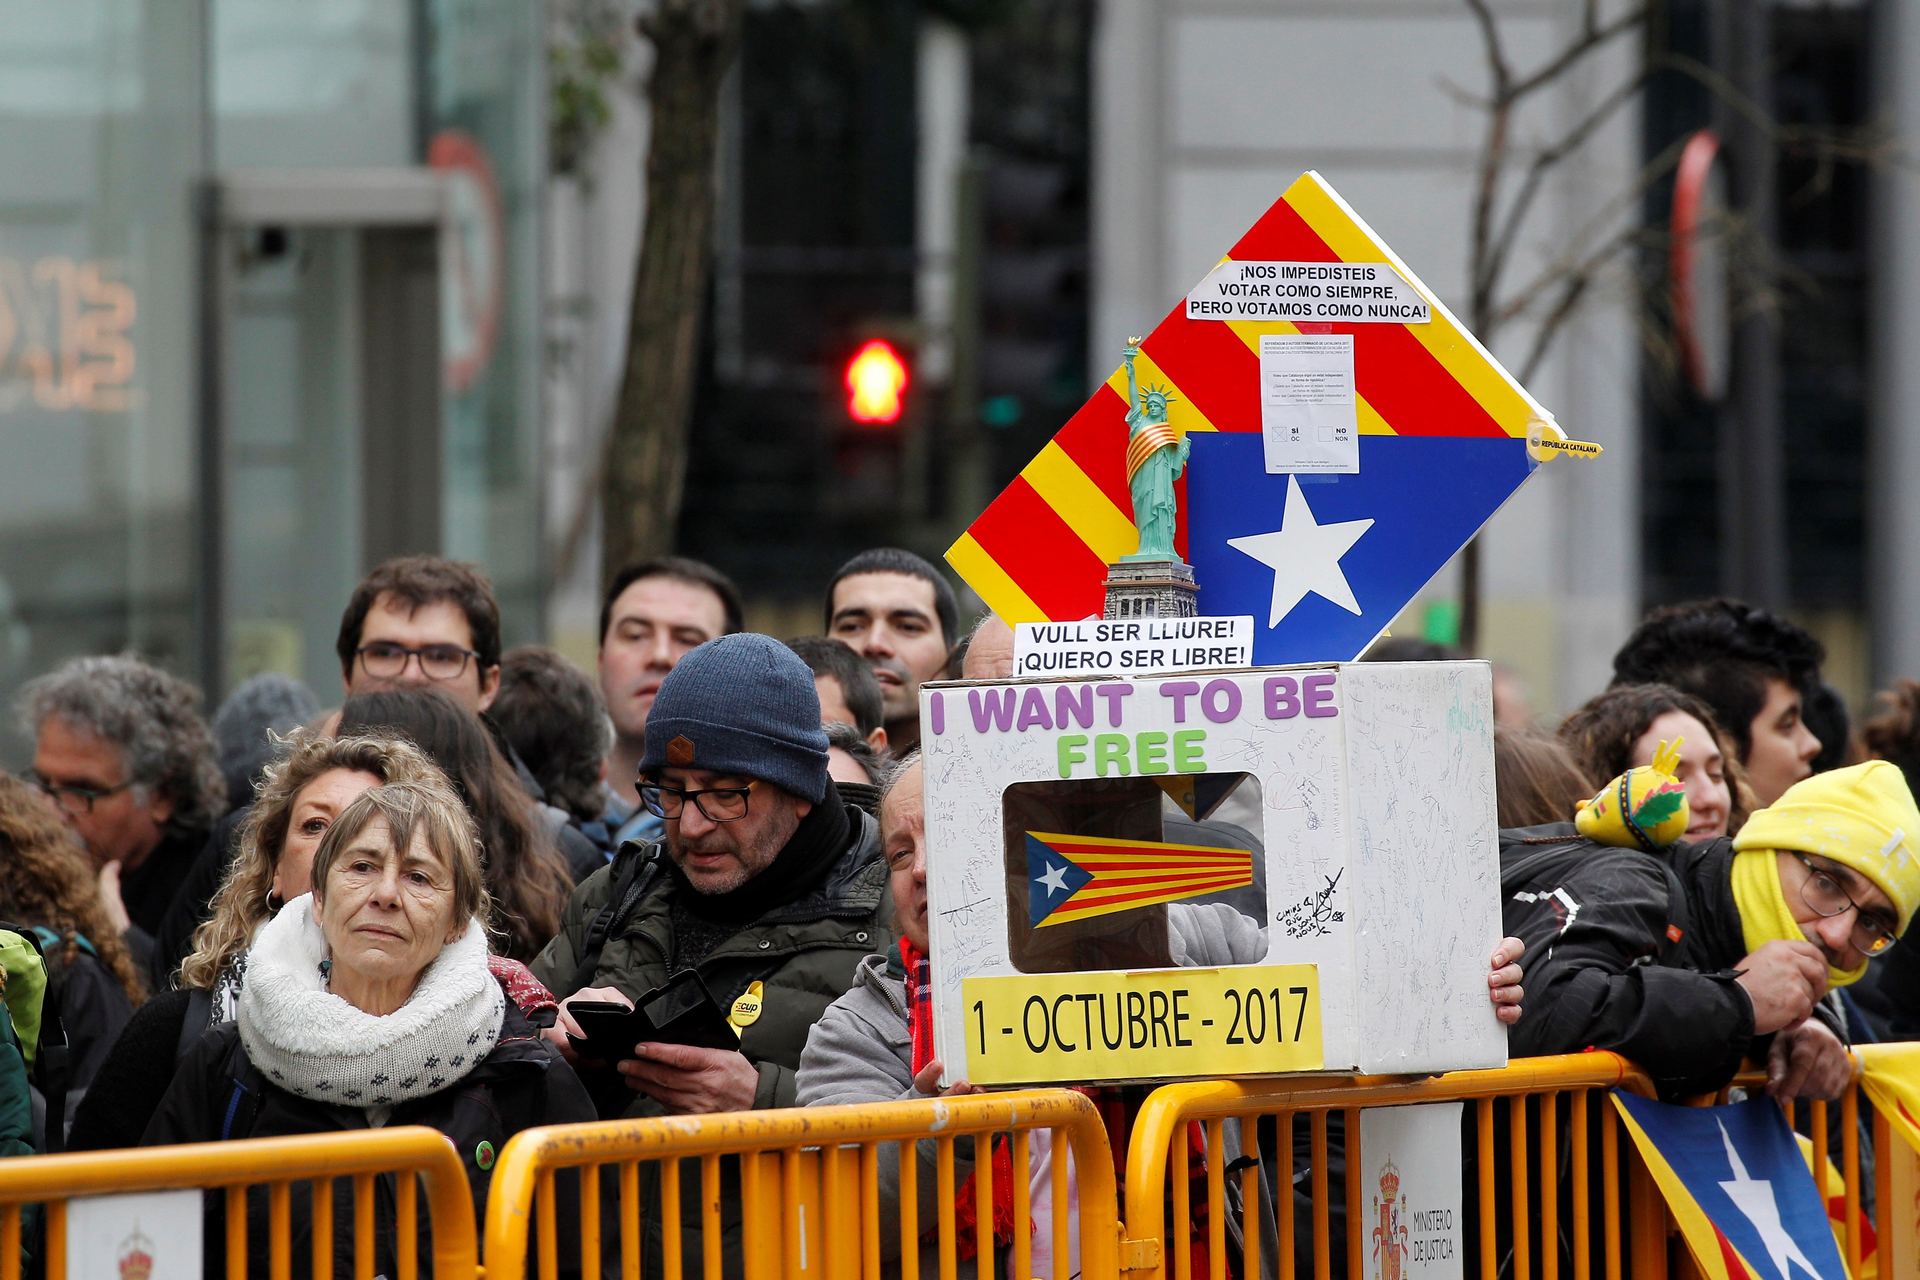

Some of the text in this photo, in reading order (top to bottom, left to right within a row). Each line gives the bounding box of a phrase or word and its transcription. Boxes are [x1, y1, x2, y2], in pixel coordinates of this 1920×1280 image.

[1240, 266, 1376, 281] ¡NOS IMPEDISTEIS
[1218, 283, 1398, 301] VOTAR COMO SIEMPRE,
[1190, 301, 1427, 318] PERO VOTAMOS COMO NUNCA!
[1031, 620, 1235, 644] VULL SER LLIURE!
[1017, 646, 1246, 675] ¡QUIERO SER LIBRE!
[930, 691, 945, 735] I
[967, 683, 1134, 734] WANT
[1159, 678, 1243, 724] TO
[1262, 673, 1339, 721] BE
[1057, 729, 1208, 779] FREE
[741, 1003, 758, 1013] cup
[973, 1000, 987, 1055] 1
[1022, 989, 1193, 1054] OCTUBRE
[1223, 987, 1308, 1046] 2017
[1413, 1209, 1452, 1232] MINISTERIO
[1414, 1240, 1424, 1262] DE
